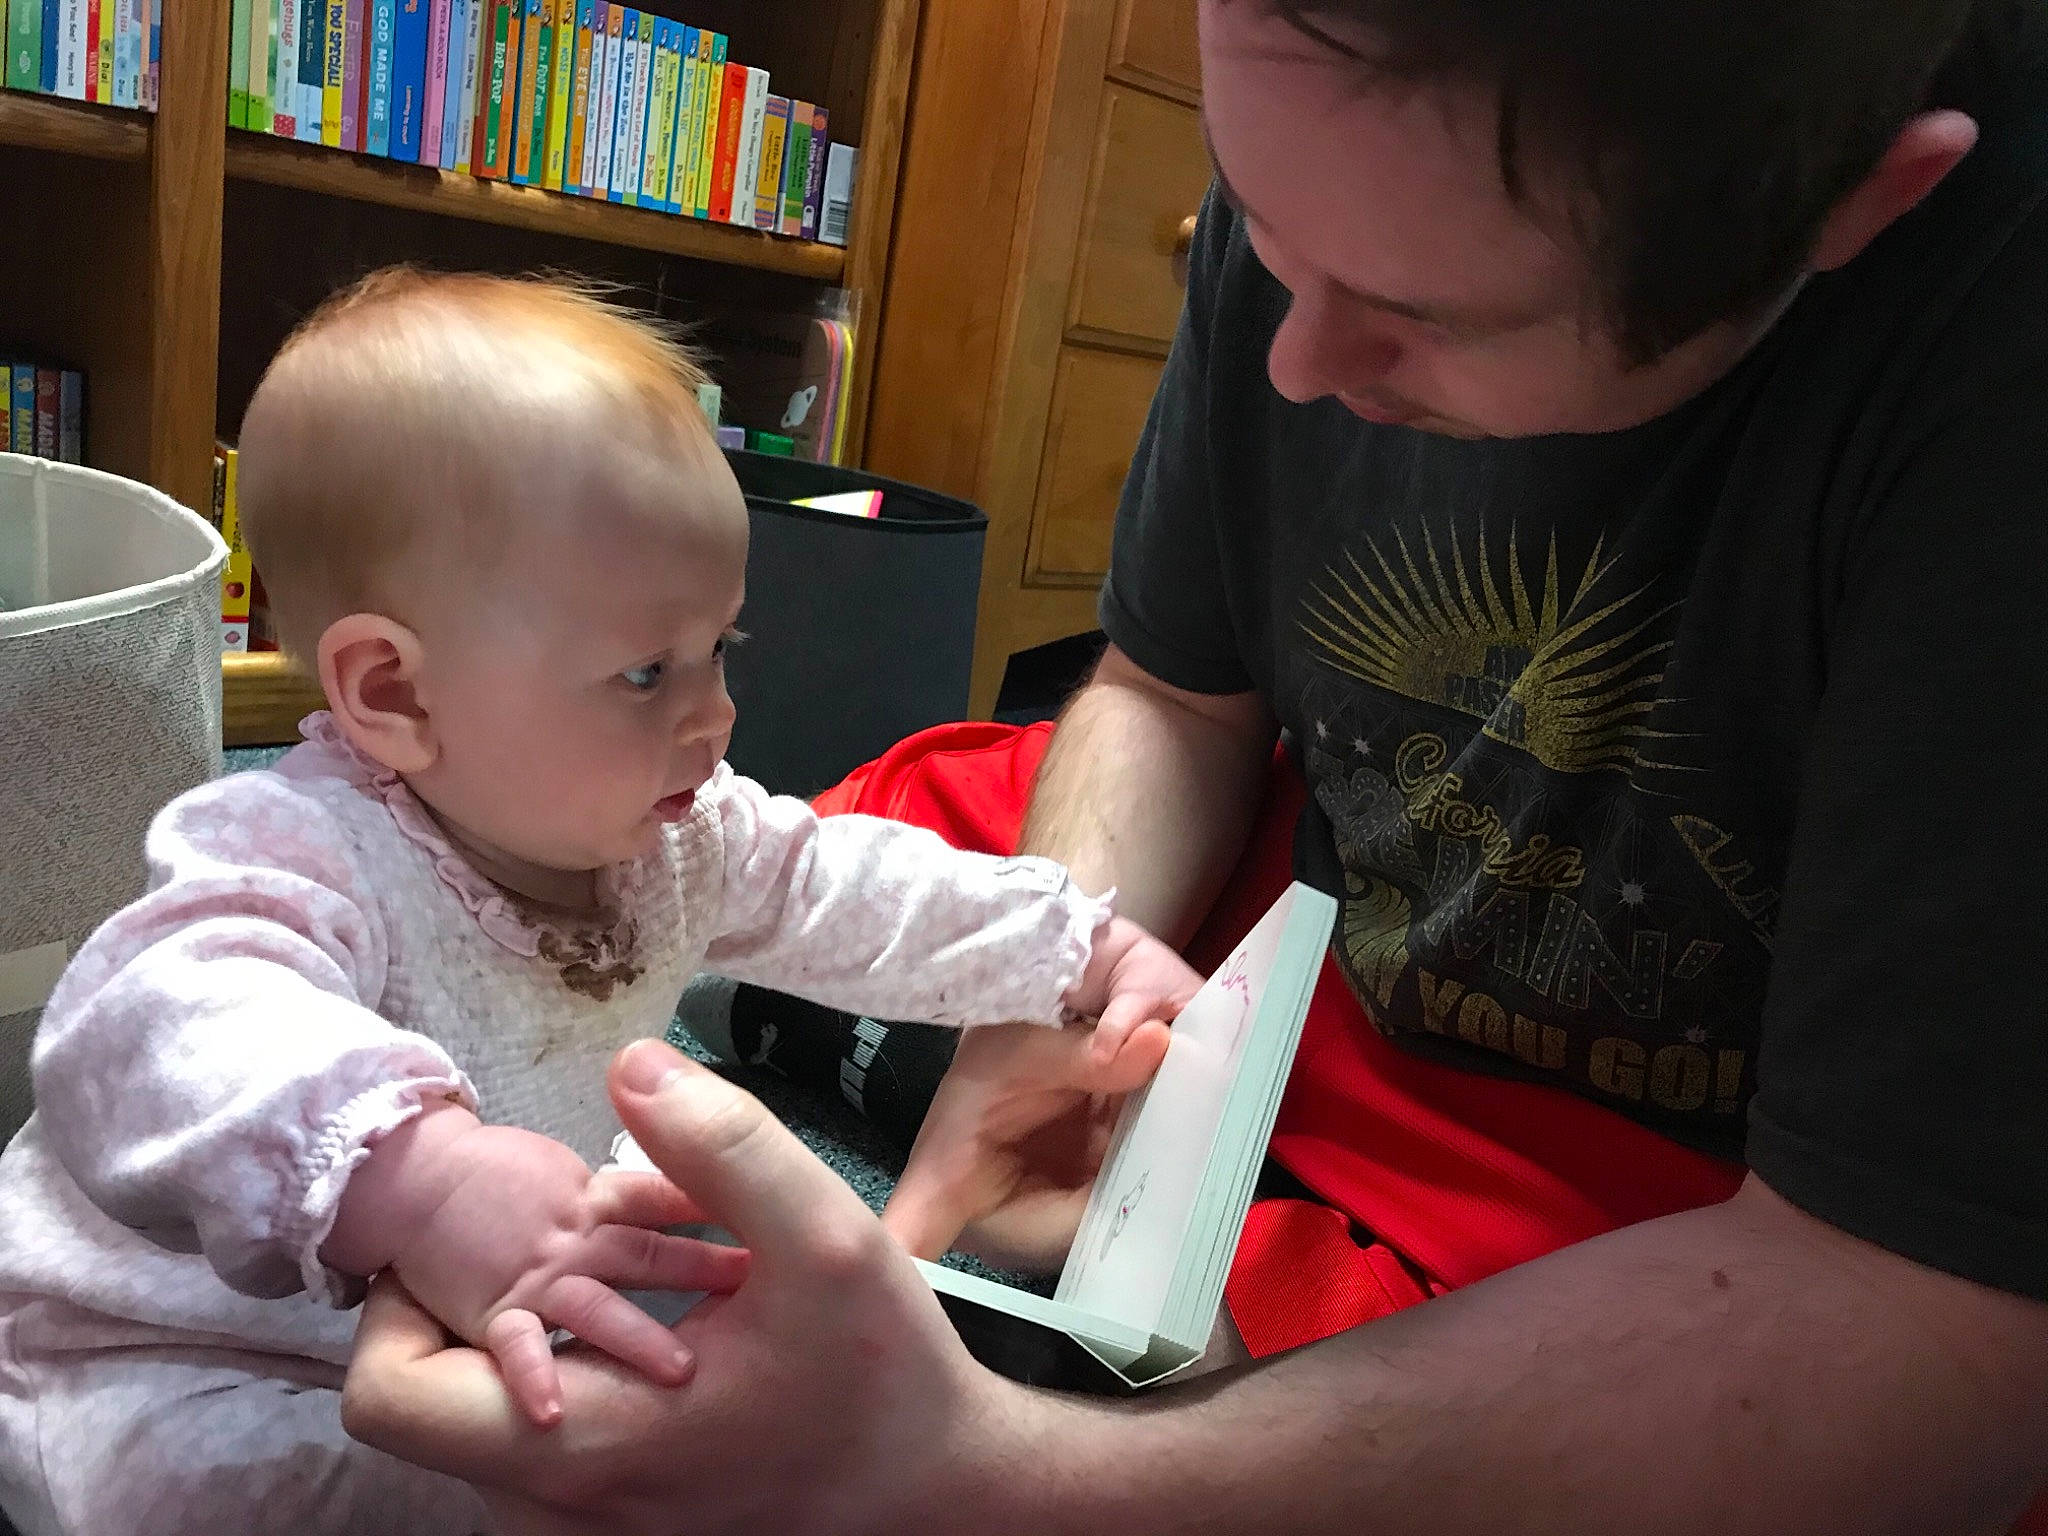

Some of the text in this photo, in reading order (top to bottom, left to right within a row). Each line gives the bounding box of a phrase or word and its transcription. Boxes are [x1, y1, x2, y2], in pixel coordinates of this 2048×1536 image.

[330, 5, 343, 28] YOU
[69, 24, 77, 42] See?
[373, 6, 389, 121] GOD MADE ME
[493, 42, 506, 69] HOP
[101, 62, 110, 83] Dial
[536, 64, 548, 93] FOOT
[576, 67, 588, 91] EYE
[490, 79, 503, 104] POP
[804, 162, 815, 198] Pumpkin
[1396, 732, 1587, 890] Cfornia
[1418, 966, 1746, 1115] YOU GO!
